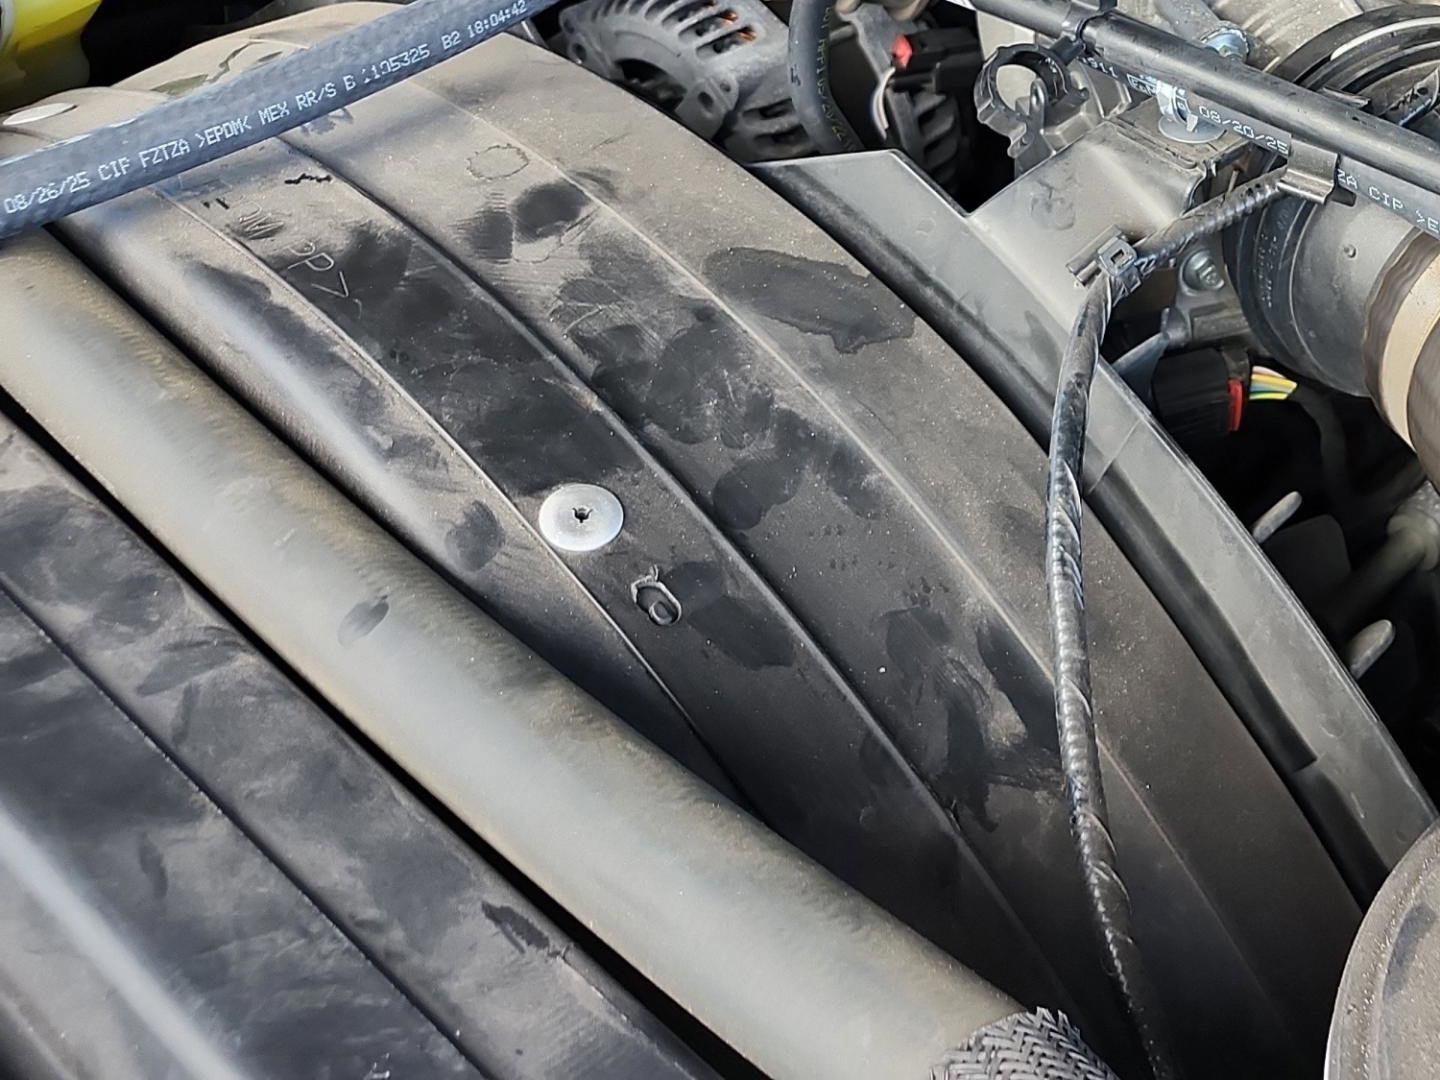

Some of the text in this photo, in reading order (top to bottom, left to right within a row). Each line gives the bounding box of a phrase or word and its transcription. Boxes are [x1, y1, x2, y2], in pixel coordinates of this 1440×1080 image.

[3, 170, 92, 214] 08/26/25
[138, 137, 191, 167] FZTZA
[198, 115, 252, 149] >EPDM<
[258, 100, 291, 126] MEX
[295, 82, 337, 113] RR/S
[442, 28, 462, 51] B2
[467, 0, 529, 39] 18:04:42
[1198, 104, 1289, 155] 08/20/25
[1368, 186, 1404, 211] CIP
